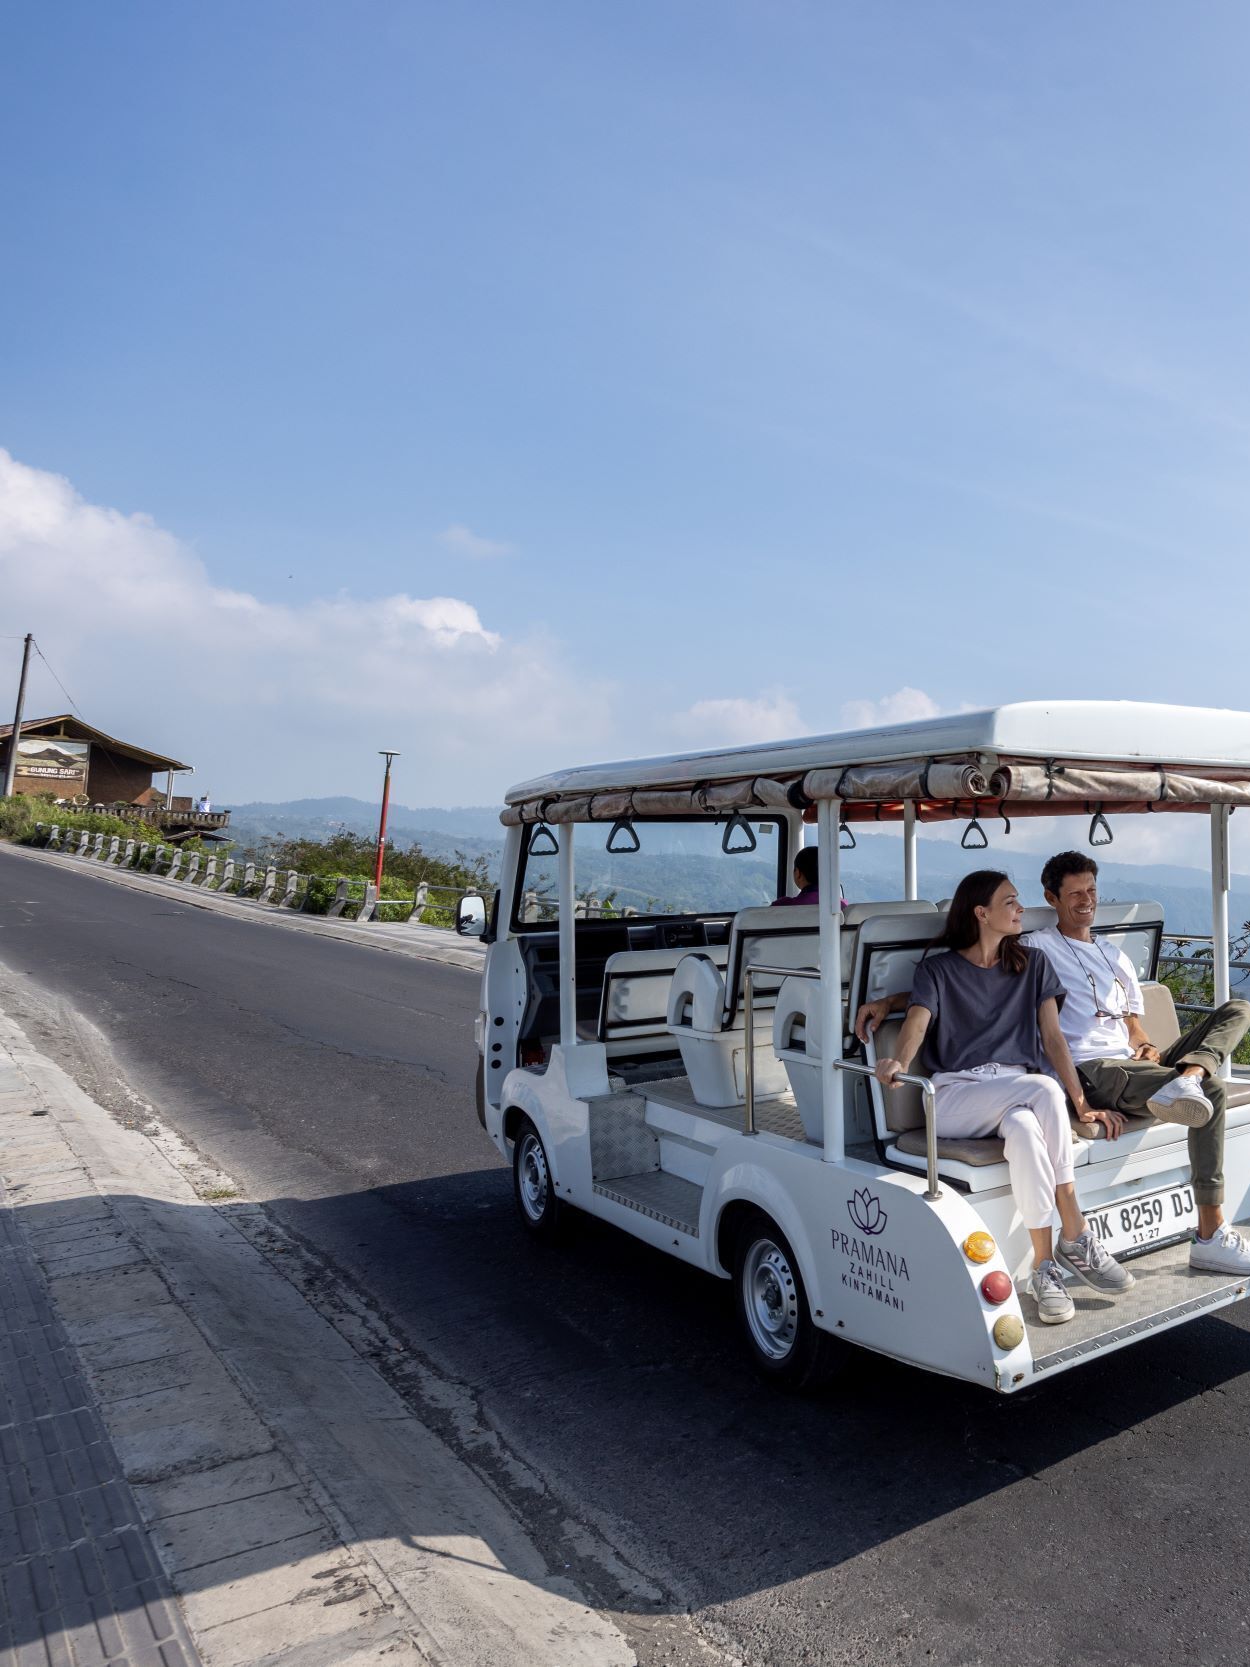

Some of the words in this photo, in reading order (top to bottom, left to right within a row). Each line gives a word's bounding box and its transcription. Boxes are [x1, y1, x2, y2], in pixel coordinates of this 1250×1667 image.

[1088, 1213, 1113, 1240] DK
[1120, 1198, 1163, 1233] 8259
[1171, 1189, 1194, 1217] DJ
[830, 1229, 910, 1281] PRAMANA
[849, 1262, 894, 1291] ZAHILL
[841, 1273, 904, 1312] KINTAMANI
